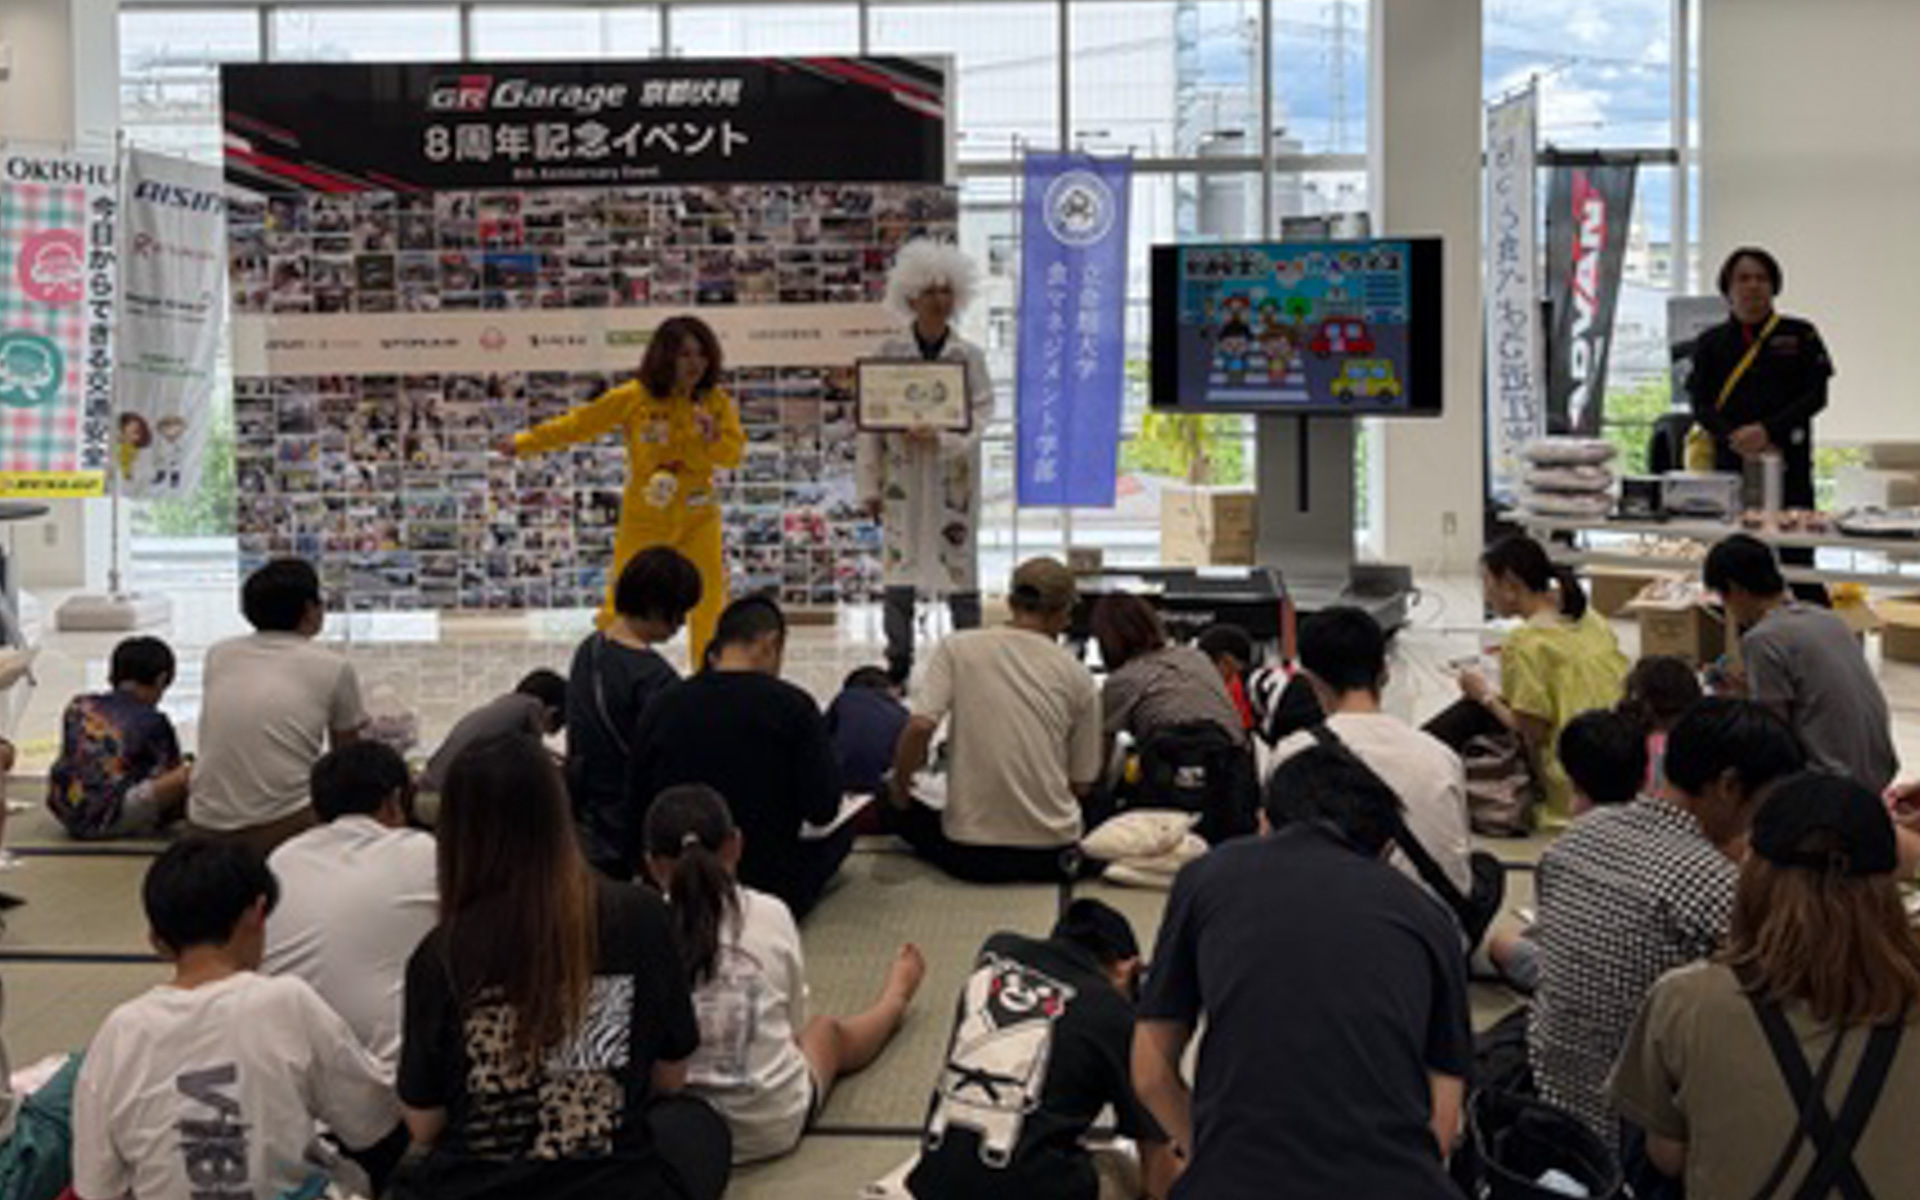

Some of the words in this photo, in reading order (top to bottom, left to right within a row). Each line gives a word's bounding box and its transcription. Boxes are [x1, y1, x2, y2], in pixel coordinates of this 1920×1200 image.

[490, 79, 629, 113] Garage
[424, 121, 749, 161] 8周年記念イベント
